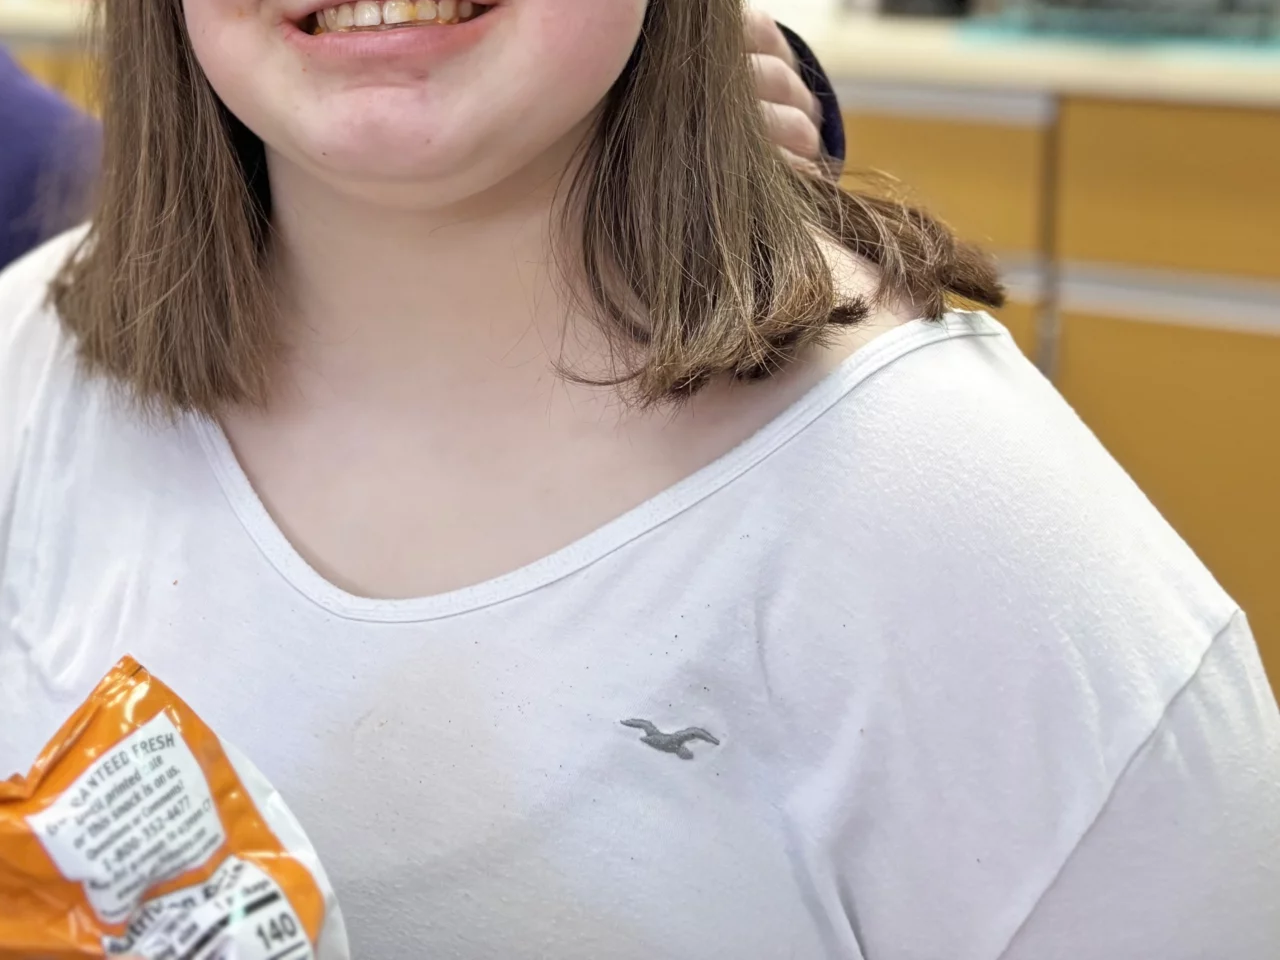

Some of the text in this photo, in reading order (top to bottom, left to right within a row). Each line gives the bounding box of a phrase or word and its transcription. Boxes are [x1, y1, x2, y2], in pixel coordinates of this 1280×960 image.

[131, 733, 176, 757] FRESH
[105, 768, 142, 807] printed
[143, 754, 164, 776] ate
[111, 790, 141, 821] snack
[142, 782, 154, 797] is
[154, 774, 166, 789] on
[166, 764, 182, 780] us.
[141, 779, 185, 819] Comments?
[255, 912, 298, 951] 140
